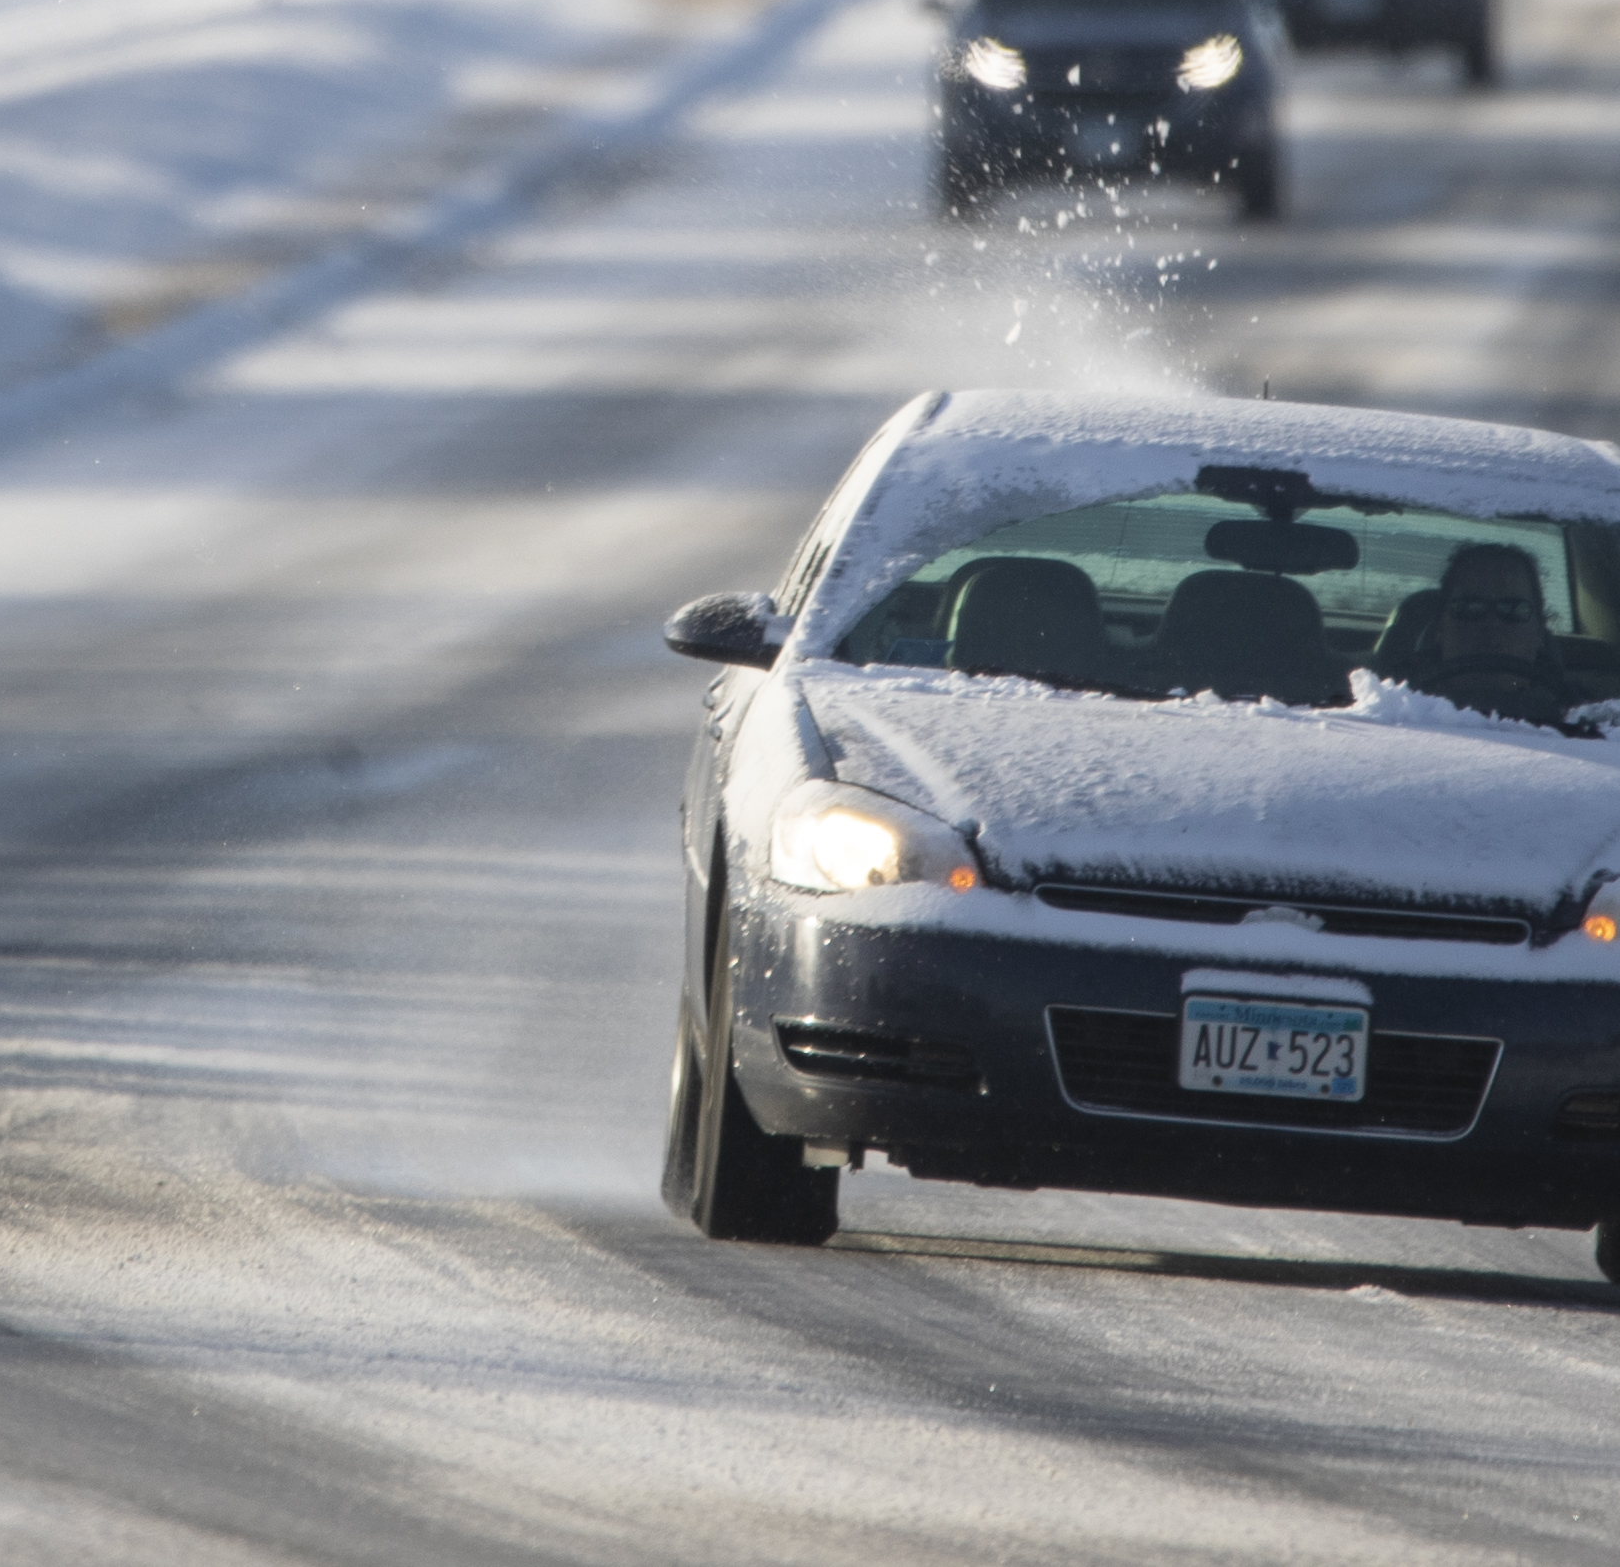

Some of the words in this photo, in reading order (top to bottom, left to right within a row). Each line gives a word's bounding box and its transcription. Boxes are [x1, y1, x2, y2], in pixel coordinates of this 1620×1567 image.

[1235, 1005, 1318, 1027] Minnesota
[1192, 1023, 1260, 1071] AUZ
[1288, 1030, 1355, 1078] 523
